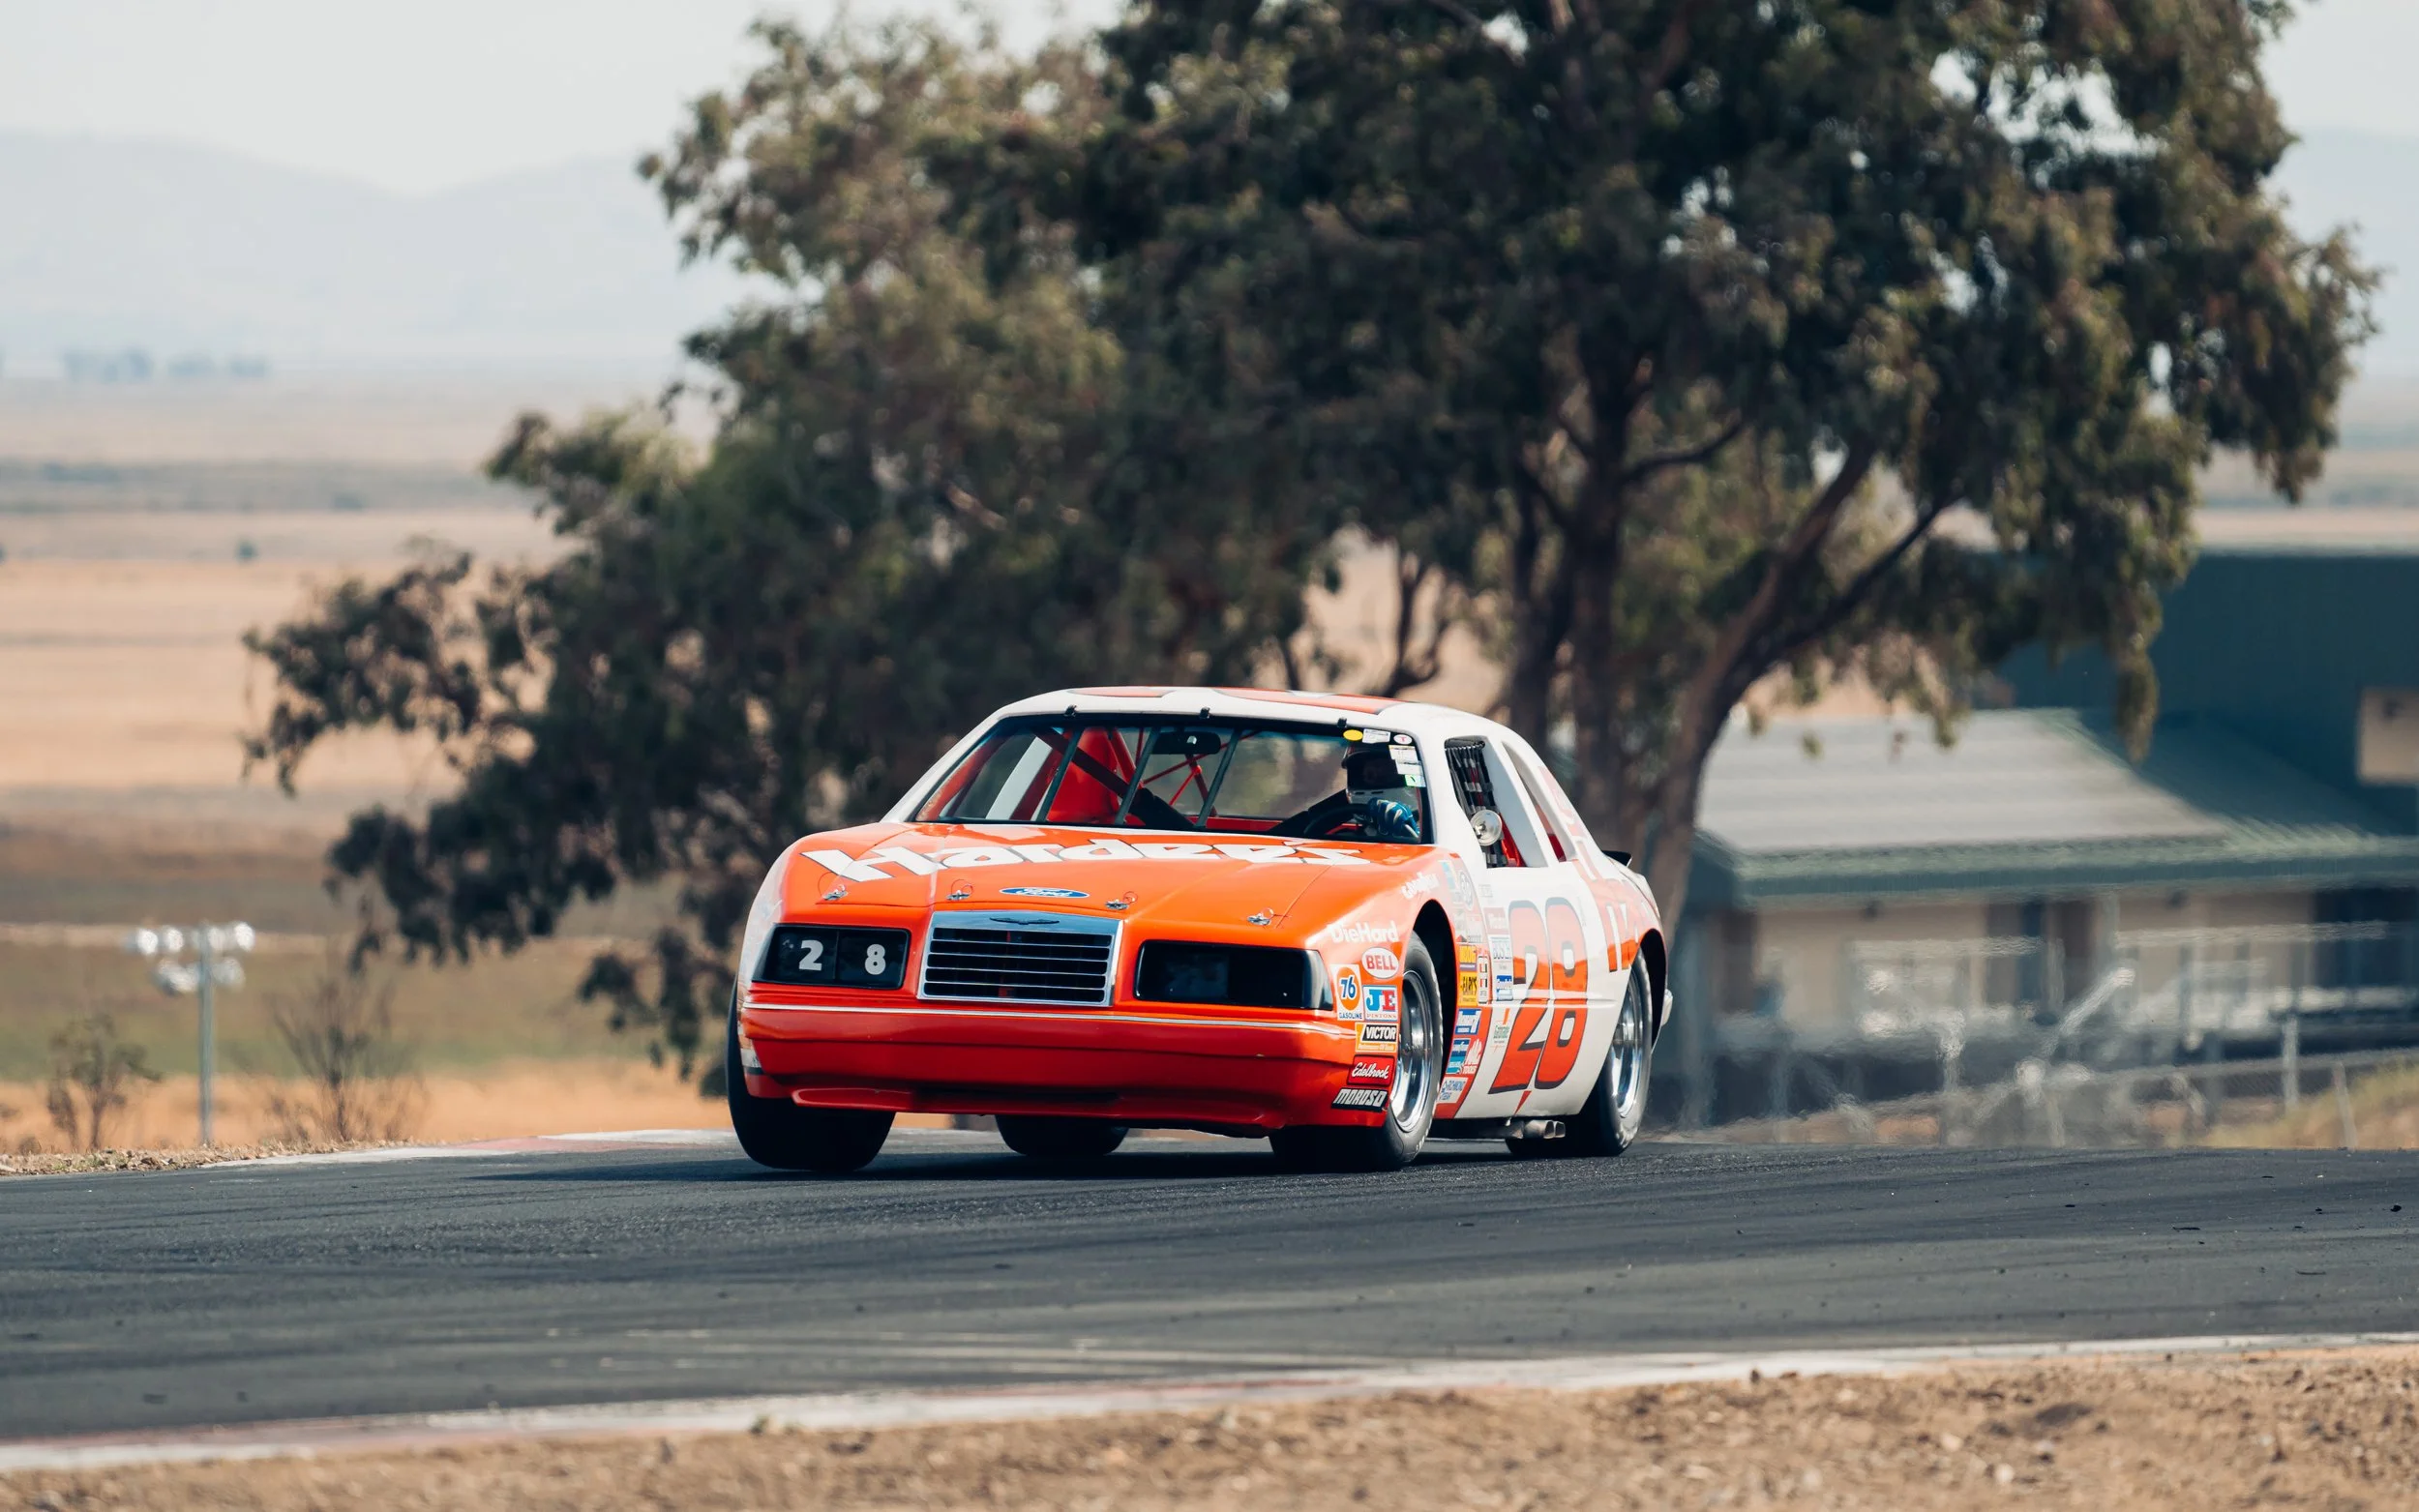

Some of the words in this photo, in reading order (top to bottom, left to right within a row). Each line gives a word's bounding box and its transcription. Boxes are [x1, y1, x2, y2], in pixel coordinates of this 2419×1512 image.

[800, 839, 1371, 882] Hardee's
[1329, 920, 1400, 944] DieHard
[798, 939, 823, 971] 2
[864, 944, 886, 975] 8
[1365, 954, 1396, 971] BELL
[1340, 975, 1357, 999] 76
[1488, 897, 1588, 1095] 28
[1366, 989, 1396, 1012] JE
[1365, 1026, 1397, 1040] VICTOR
[1351, 1062, 1390, 1080] Edelbrock
